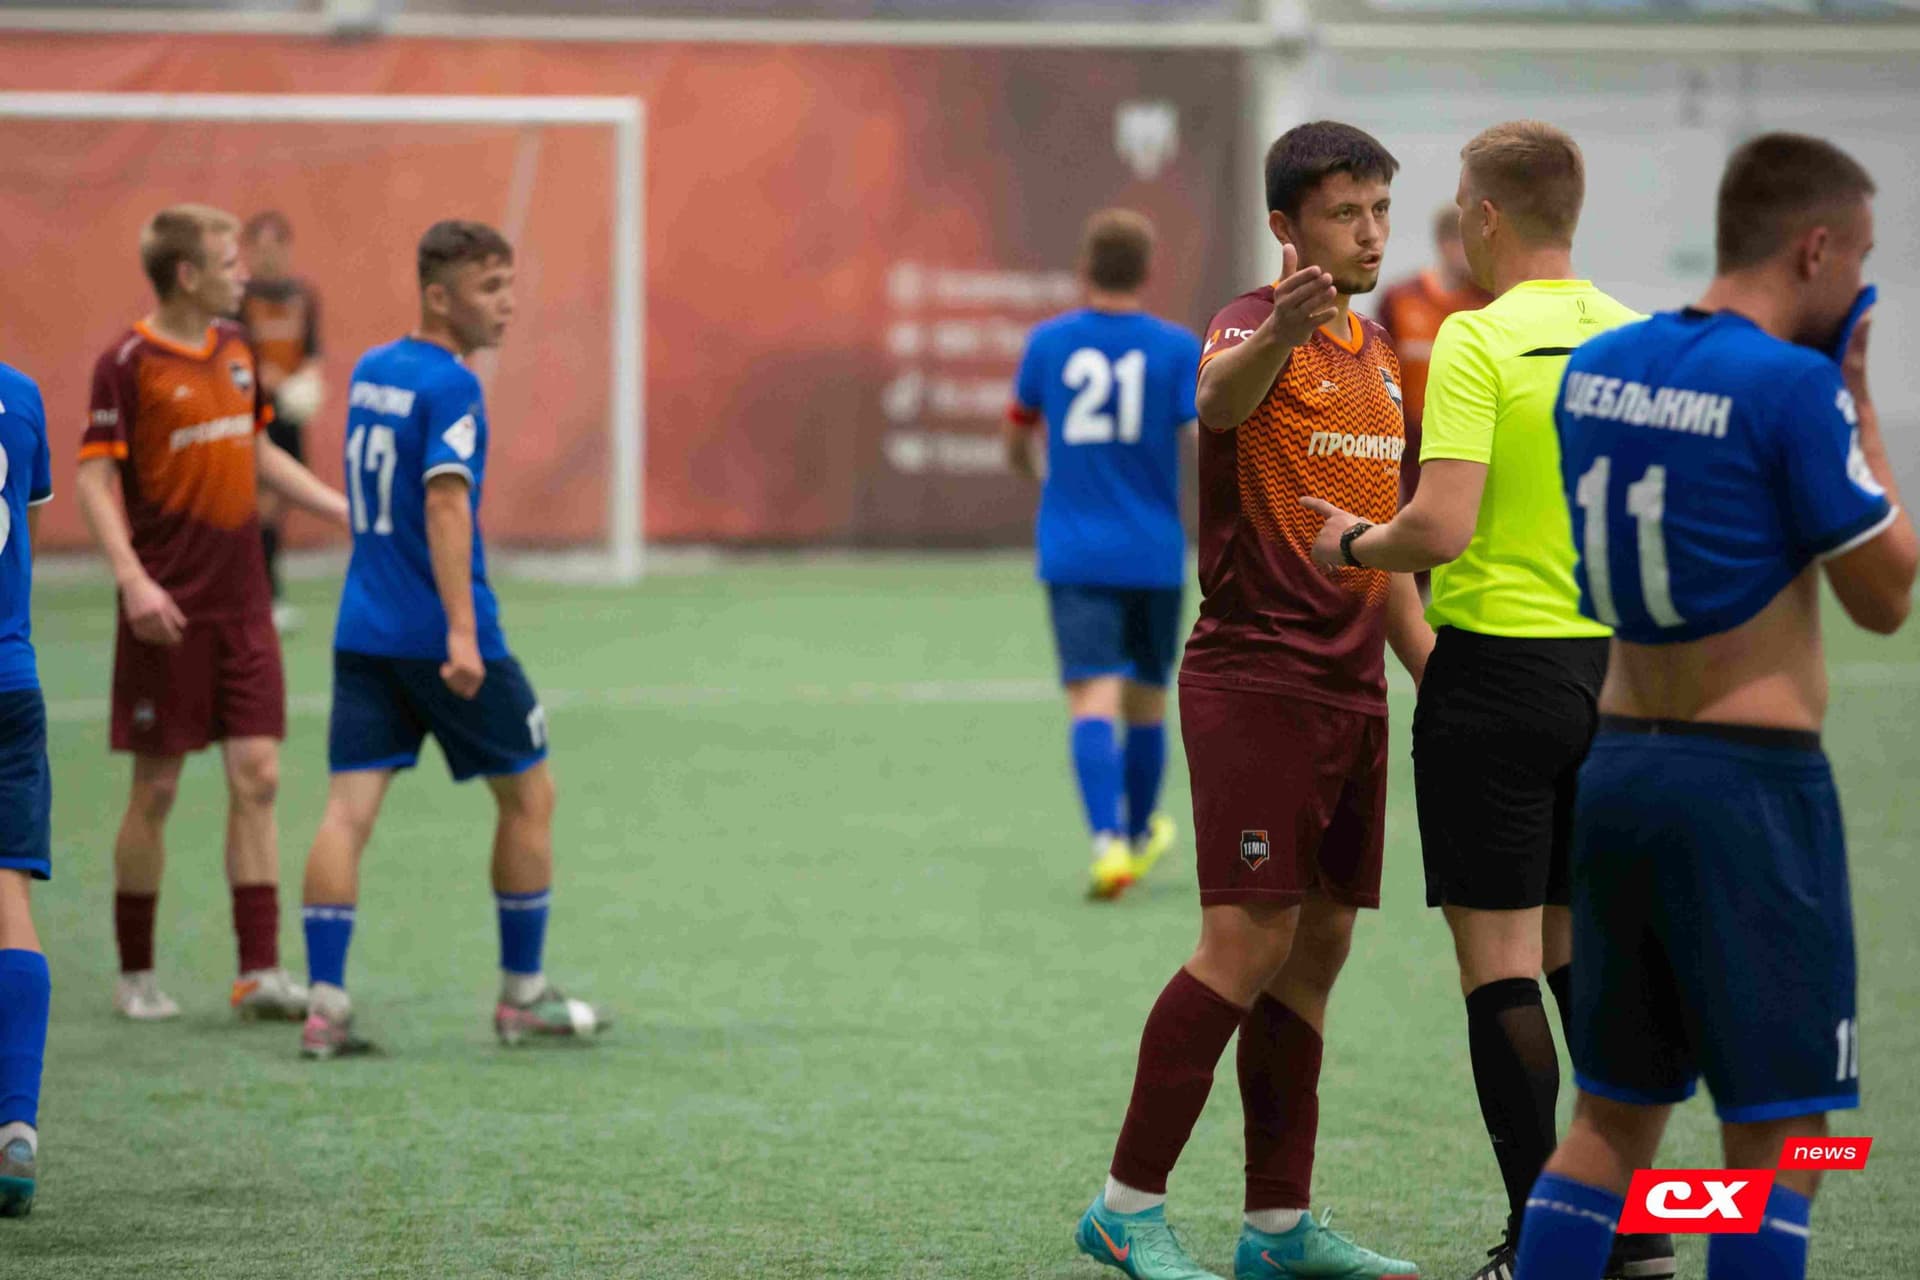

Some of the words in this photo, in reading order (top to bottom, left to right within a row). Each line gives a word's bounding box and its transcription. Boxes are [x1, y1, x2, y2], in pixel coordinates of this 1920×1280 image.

[1062, 348, 1147, 444] 21
[347, 423, 398, 535] 17
[1576, 456, 1687, 628] 11
